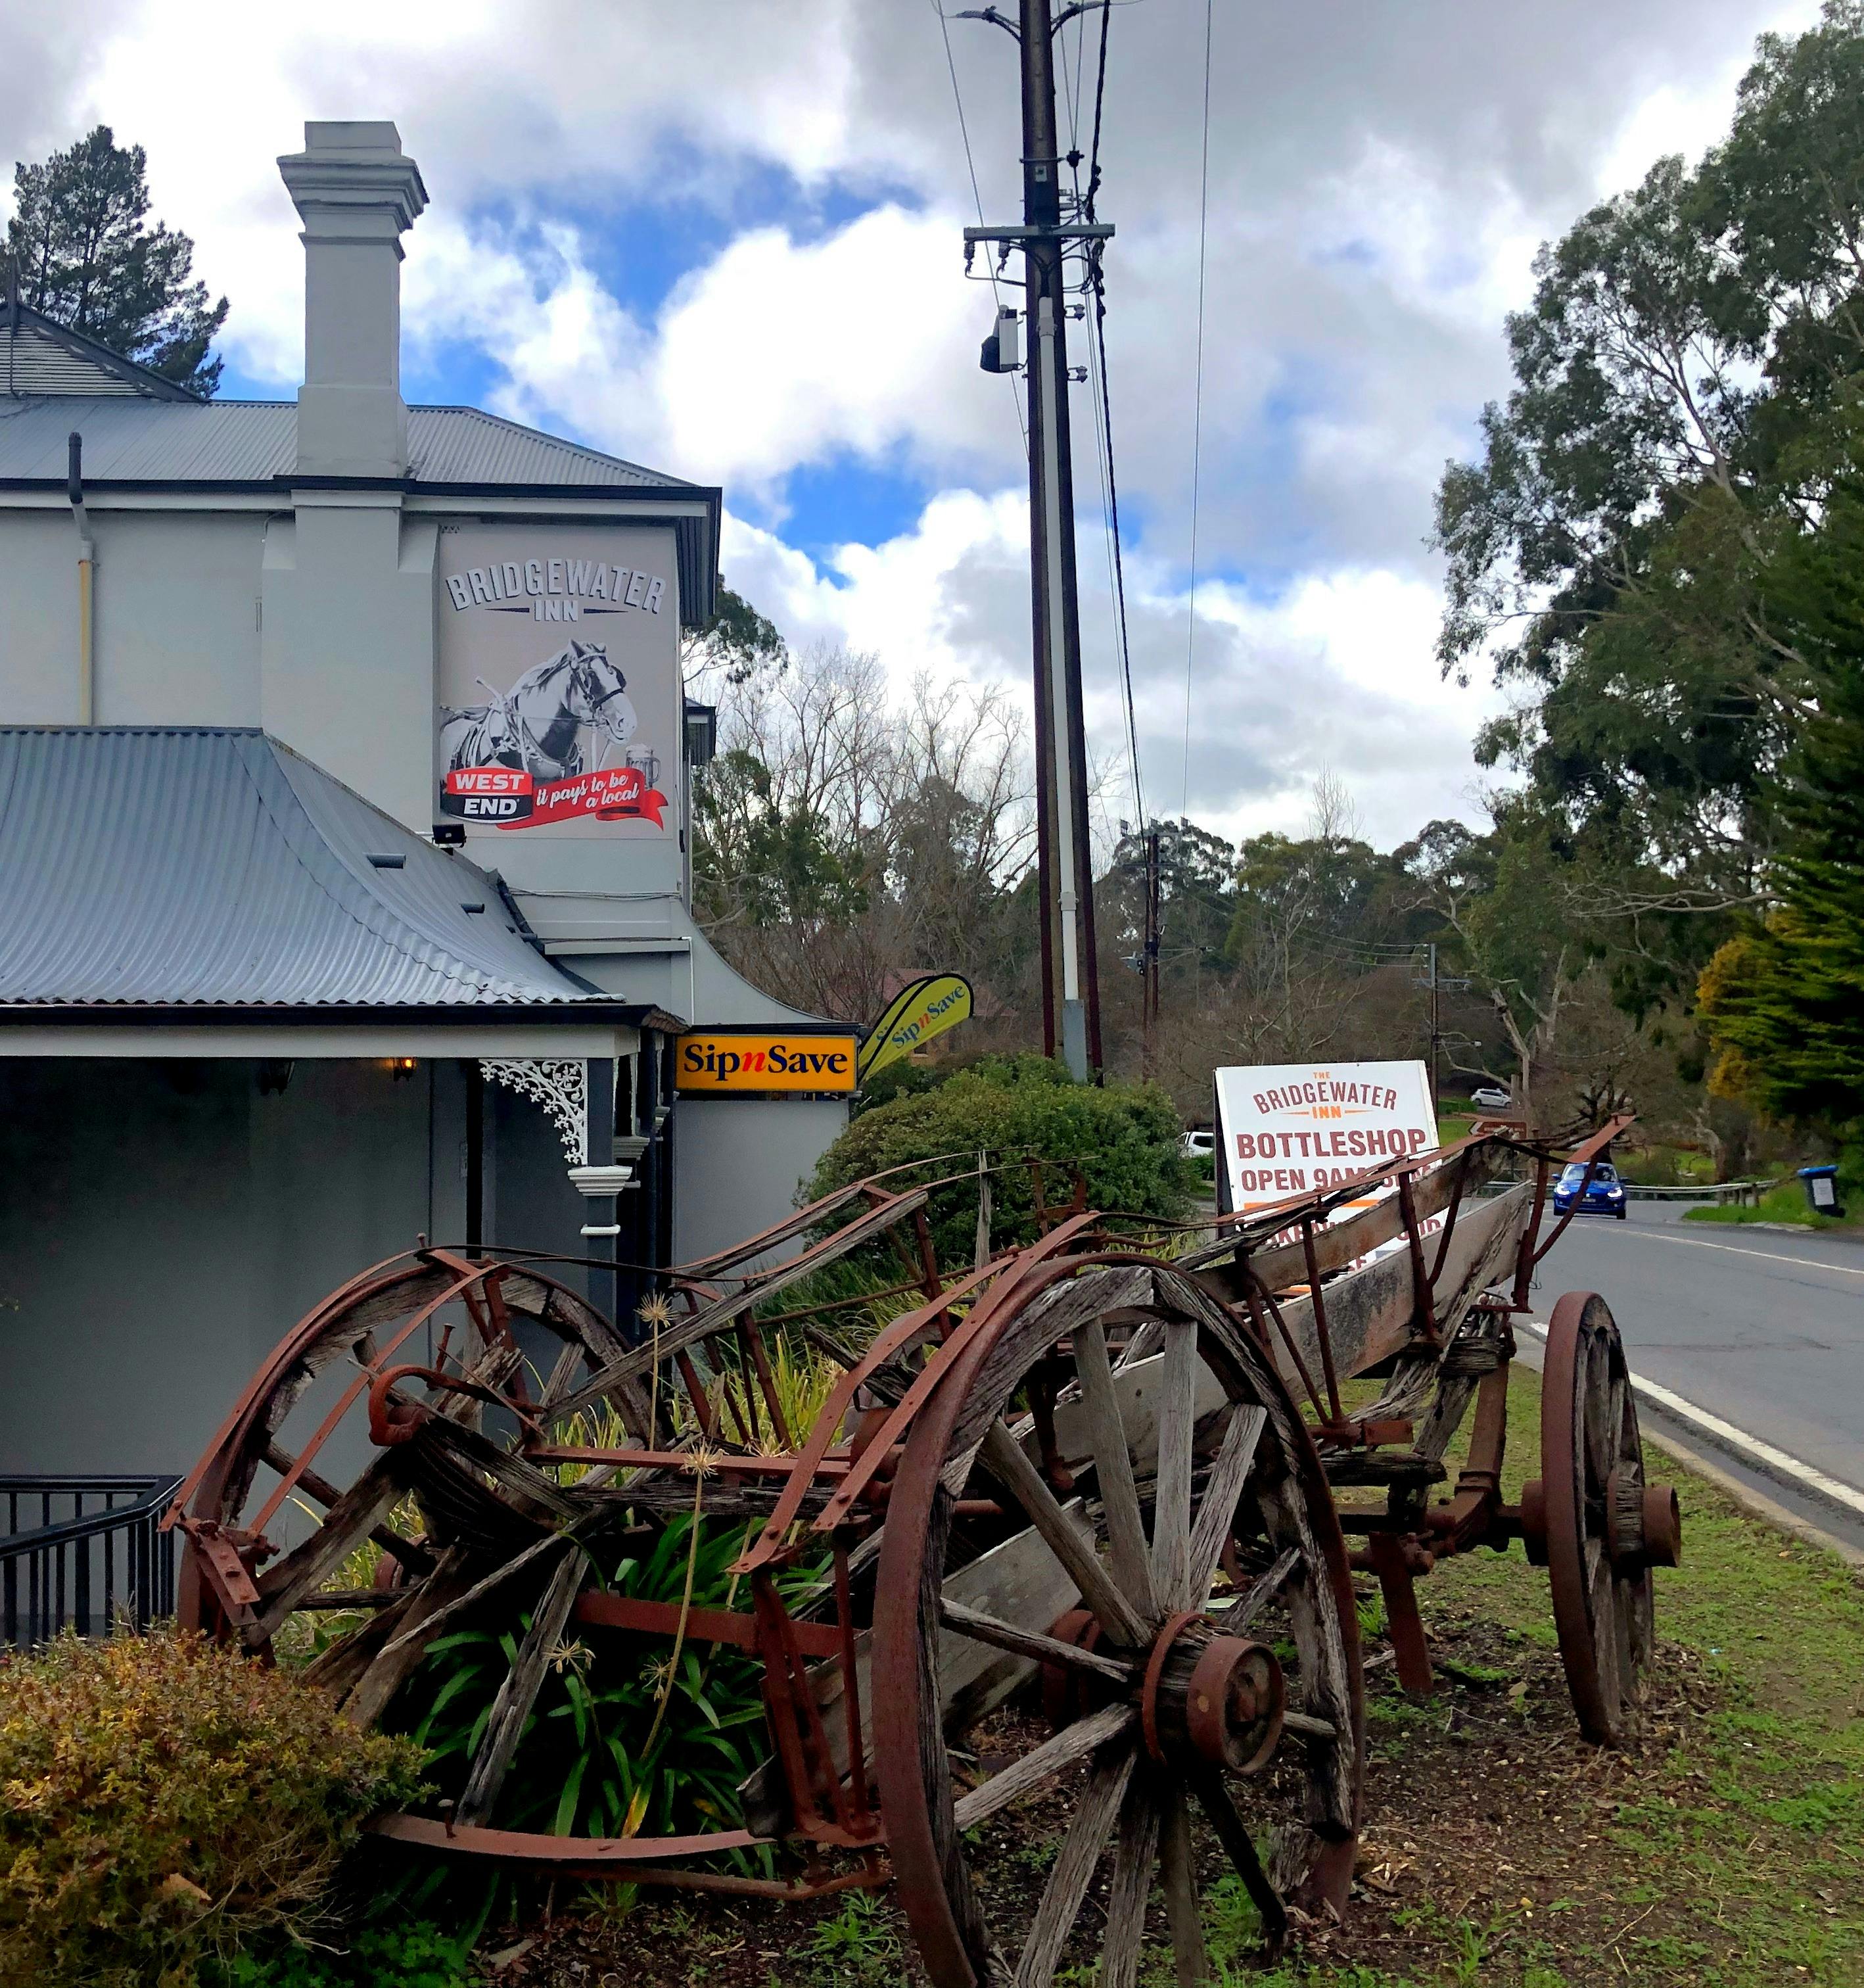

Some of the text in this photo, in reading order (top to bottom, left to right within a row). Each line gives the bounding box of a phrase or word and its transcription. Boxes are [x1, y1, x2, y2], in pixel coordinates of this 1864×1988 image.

[446, 558, 666, 615] BRIDGEWATER
[534, 600, 578, 622] INN
[455, 774, 524, 790] WEST
[549, 779, 588, 808] pays
[590, 776, 605, 792] to
[609, 772, 628, 788] be
[463, 798, 517, 815] END
[585, 782, 639, 809] a local
[1313, 1071, 1331, 1079] THE
[1253, 1081, 1397, 1114] BRIDGEWATER
[1312, 1106, 1342, 1119] INN
[1236, 1128, 1426, 1159] BOTTLESHOP
[1241, 1168, 1306, 1191] OPEN
